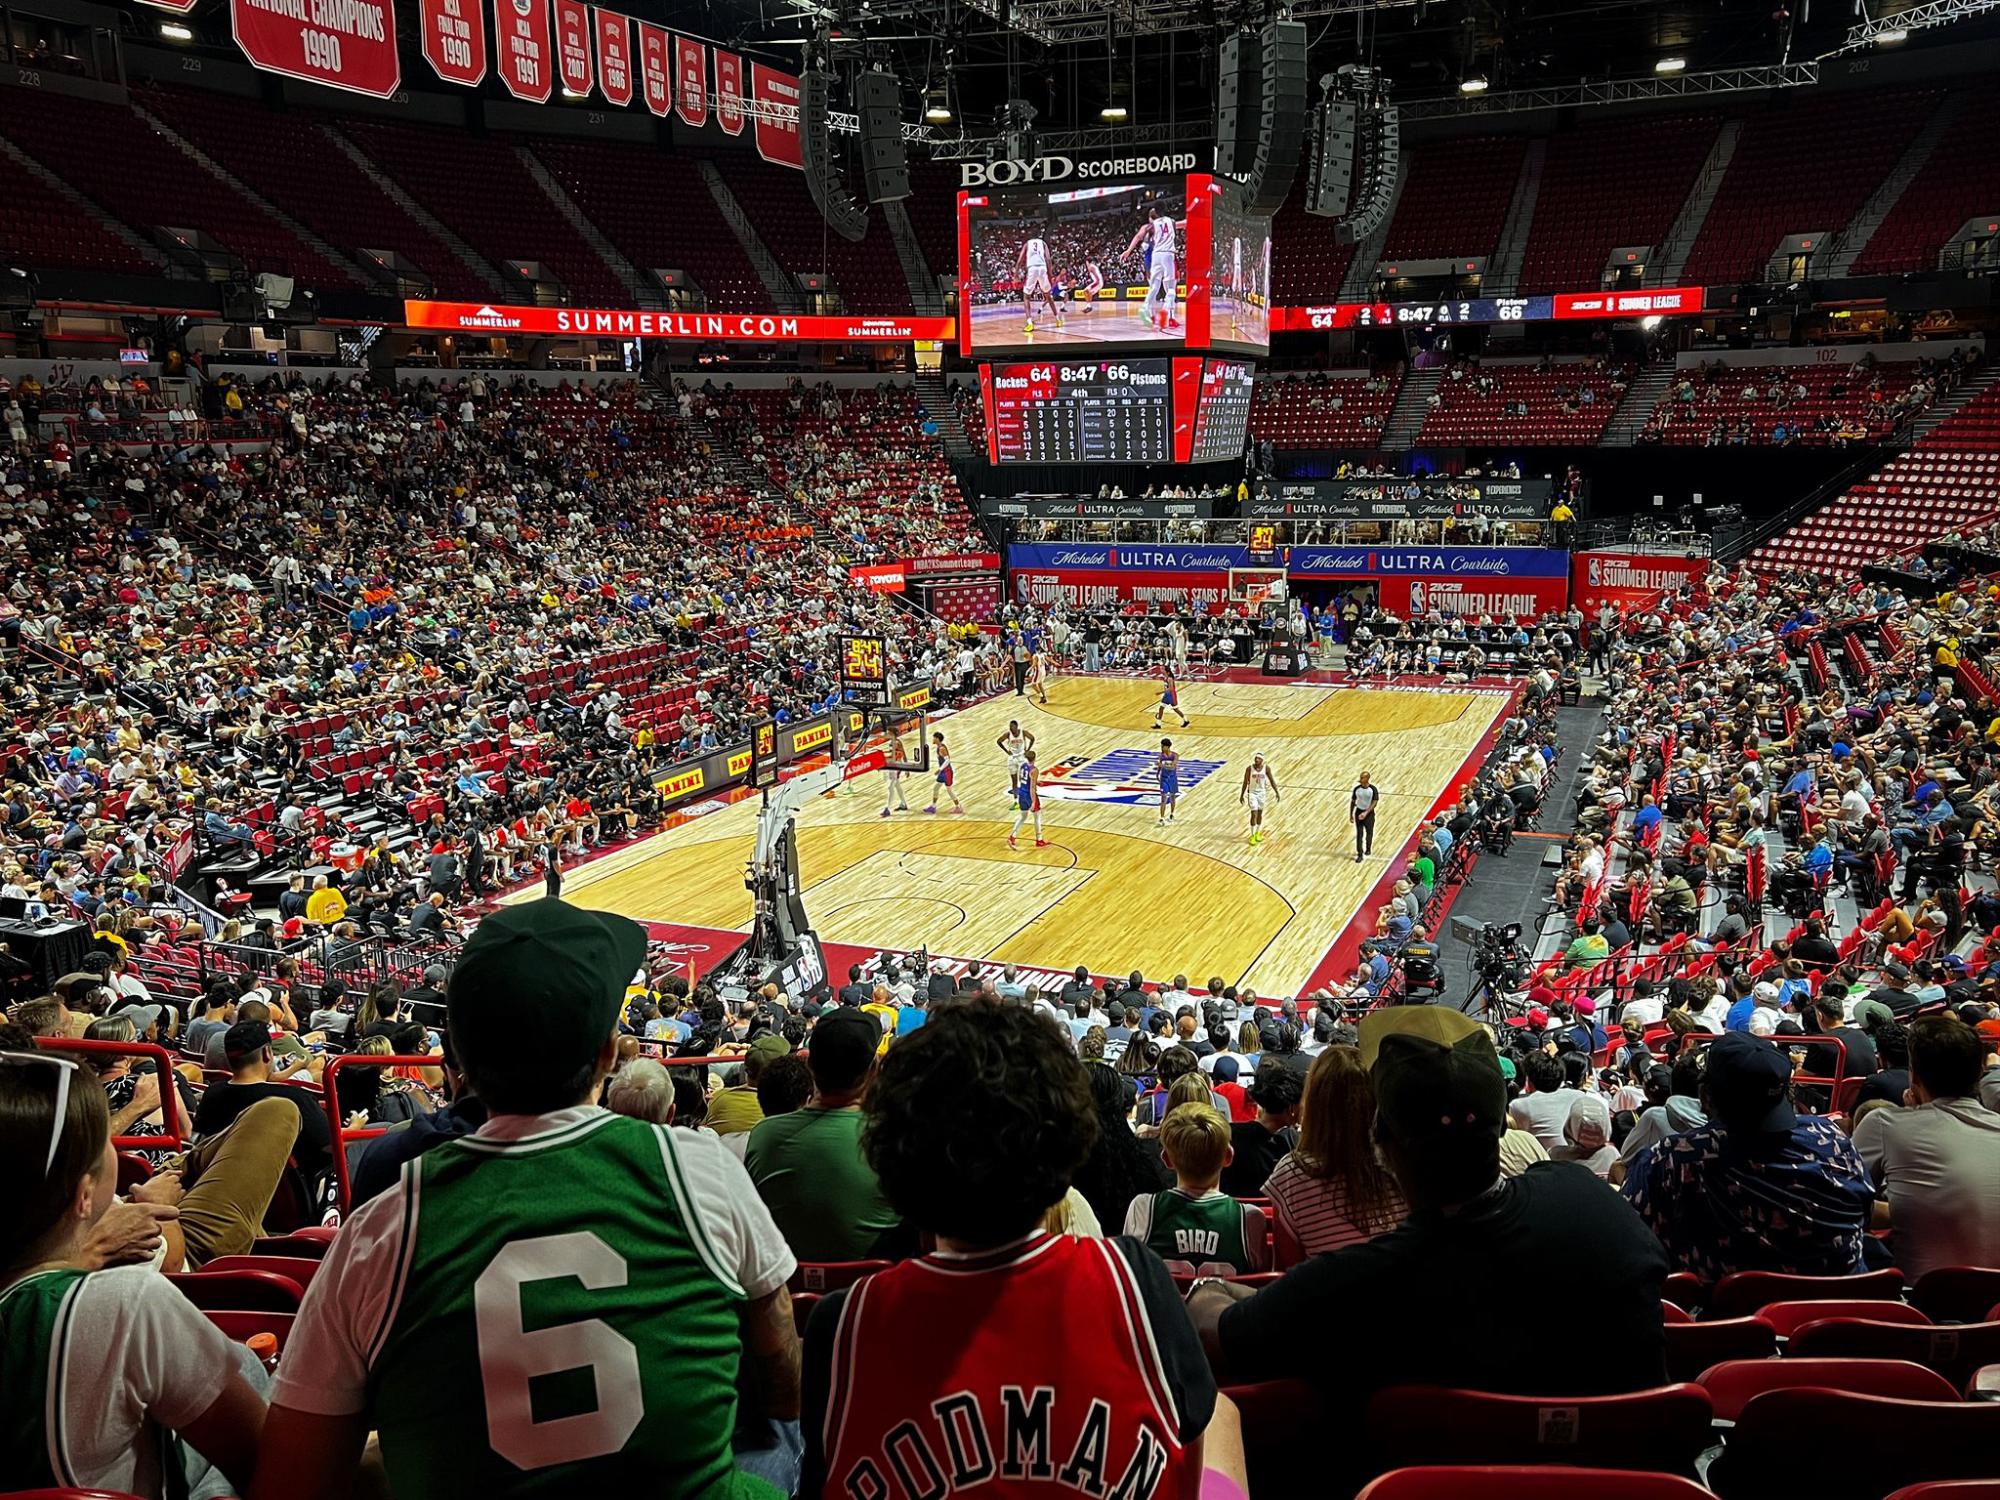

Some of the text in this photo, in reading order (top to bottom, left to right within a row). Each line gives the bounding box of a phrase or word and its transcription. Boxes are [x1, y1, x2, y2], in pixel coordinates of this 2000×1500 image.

[311, 0, 385, 43] CHAMPIONS
[300, 28, 342, 72] 1990
[441, 36, 471, 69] 1990
[182, 57, 201, 72] 229
[515, 56, 540, 86] 1991
[566, 57, 585, 80] 2007
[1849, 60, 1870, 73] 202
[18, 70, 41, 86] 228
[607, 68, 626, 90] 1986
[589, 113, 605, 124] 231
[960, 156, 1073, 186] BOYD
[1078, 153, 1196, 179] SCOREBOARD
[1159, 224, 1169, 235] 14
[1032, 242, 1039, 252] 3
[1652, 295, 1681, 308] LEAGUE
[1306, 307, 1337, 315] Rockets
[1361, 308, 1371, 318] 2
[1384, 309, 1391, 317] 1
[1398, 307, 1434, 321] 8:47
[1460, 303, 1470, 314] 2
[1499, 306, 1522, 320] 66
[459, 316, 520, 328] SUMMERLIN
[557, 311, 797, 336] SUMMERLIN.COM
[1311, 315, 1332, 328] 64
[847, 327, 911, 336] SUMMERLIN
[1815, 349, 1838, 362] 102
[51, 364, 74, 381] 117
[1030, 365, 1129, 382] 64 8:47 66
[1130, 373, 1166, 385] Pistons
[996, 377, 1028, 388] Rockets
[1048, 390, 1052, 398] 1
[1071, 389, 1088, 397] 4th
[1121, 387, 1128, 396] 0
[1023, 410, 1028, 418] 4
[1038, 410, 1043, 418] 3
[1053, 410, 1058, 418] 0
[1107, 408, 1161, 417] 20 1 2 1
[1024, 421, 1029, 429] 5
[1039, 421, 1044, 429] 3
[1068, 420, 1073, 428] 0
[1109, 420, 1114, 428] 5
[1125, 419, 1130, 427] 6
[1142, 419, 1146, 427] 1
[1022, 432, 1031, 440] 13
[1110, 431, 1115, 439] 0
[1126, 431, 1131, 439] 2
[1157, 430, 1161, 438] 1
[1024, 442, 1031, 450] 11
[1040, 442, 1045, 450] 3
[1126, 441, 1131, 449] 1
[1142, 451, 1147, 459] 0
[1157, 451, 1162, 459] 0
[1084, 505, 1115, 514] ULTRA
[1293, 504, 1327, 514] ULTRA
[1463, 504, 1500, 514] ULTRA
[1252, 535, 1272, 549] 24
[1052, 551, 1232, 570] Michelob ULTRA Courtside
[1301, 553, 1510, 574] Michelob ULTRA Courtside
[869, 573, 904, 585] TOYOTA
[1602, 567, 1689, 590] SUMMER LEAGUE
[1428, 583, 1463, 592] 2K25
[1191, 587, 1219, 603] STARS
[1428, 593, 1536, 617] SUMMER LEAGUE
[852, 639, 880, 654] 8:47
[848, 652, 878, 677] 24
[902, 692, 928, 707] PANINI
[795, 729, 831, 749] PANINI
[1175, 1229, 1220, 1256] BIRD
[474, 1231, 645, 1471] 6
